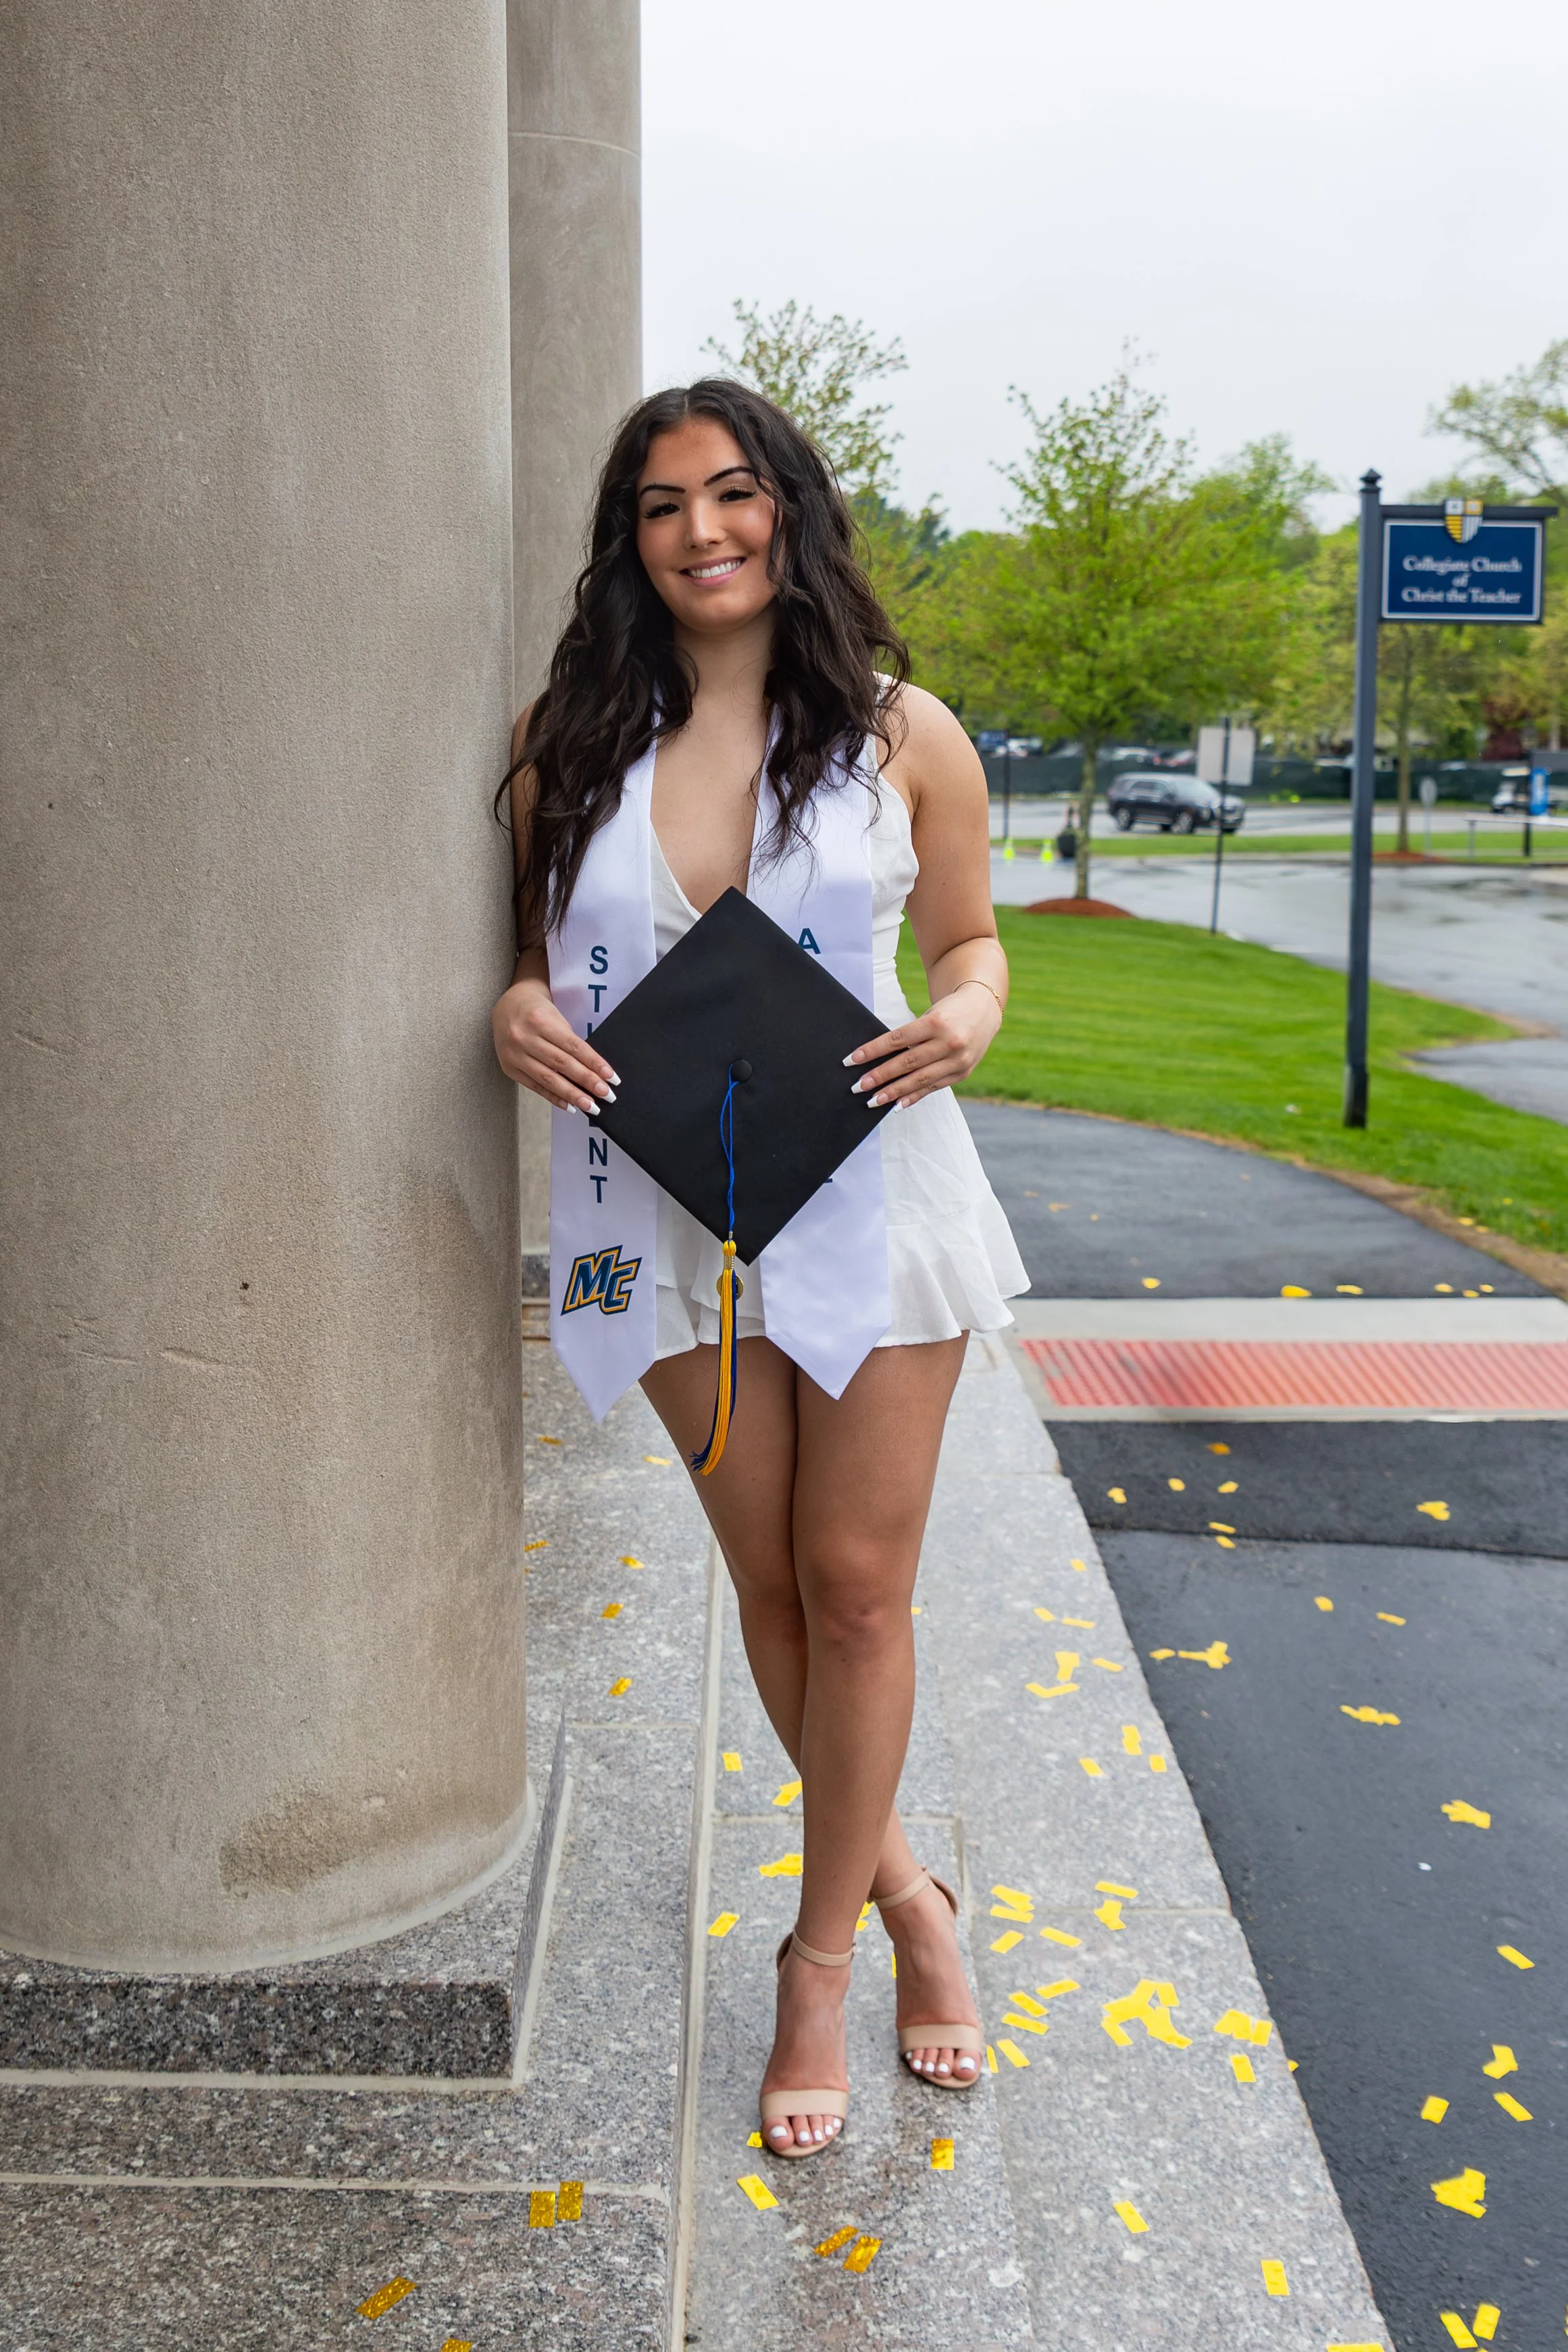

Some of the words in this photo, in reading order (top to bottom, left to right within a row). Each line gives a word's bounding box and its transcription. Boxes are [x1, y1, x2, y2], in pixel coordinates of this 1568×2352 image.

[1402, 555, 1469, 576] Collegiate
[1471, 556, 1522, 572] Church
[1452, 573, 1471, 587] of
[1402, 587, 1444, 602] Christ
[1446, 588, 1468, 603] the
[1469, 588, 1521, 603] Teacher
[587, 945, 608, 1203] STNT
[561, 1245, 642, 1316] MC
